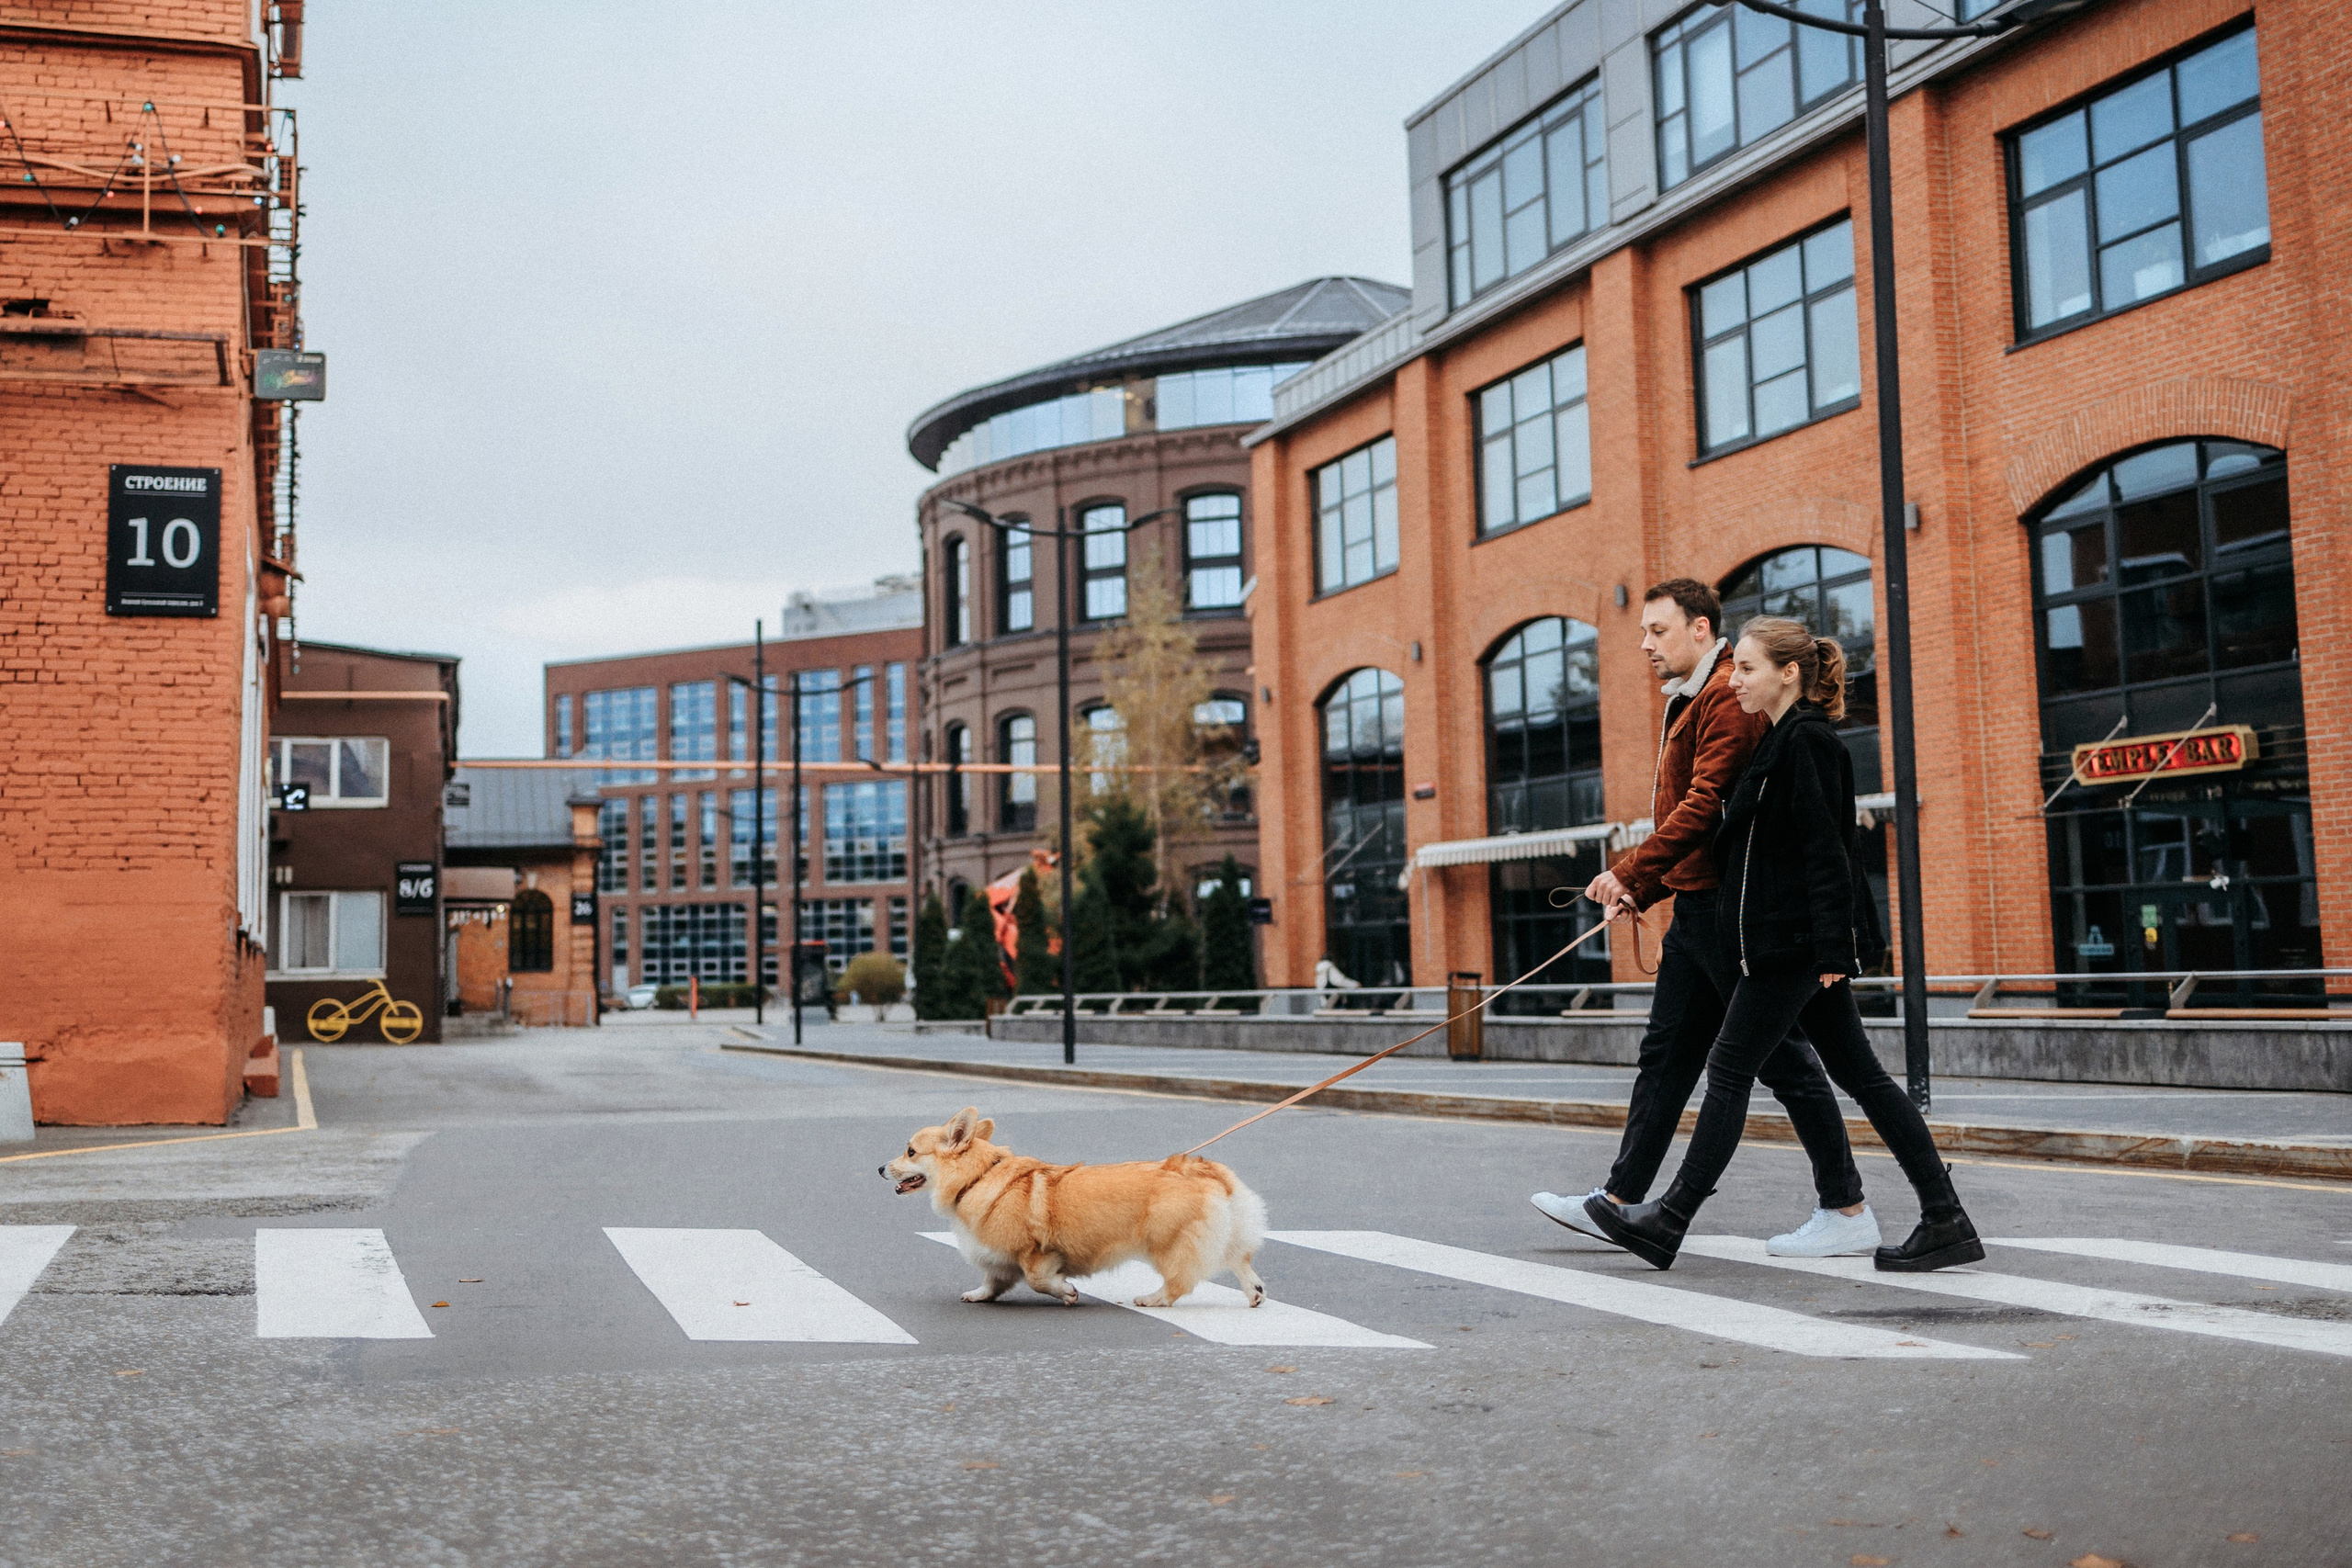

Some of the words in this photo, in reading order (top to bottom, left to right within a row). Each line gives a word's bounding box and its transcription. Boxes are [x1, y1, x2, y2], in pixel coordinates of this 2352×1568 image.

[125, 476, 208, 491] СТРОЕНИЕ
[127, 517, 201, 569] 10
[2077, 745, 2172, 773] TEMPLE
[2186, 737, 2234, 763] BAR
[399, 877, 434, 898] 8/6
